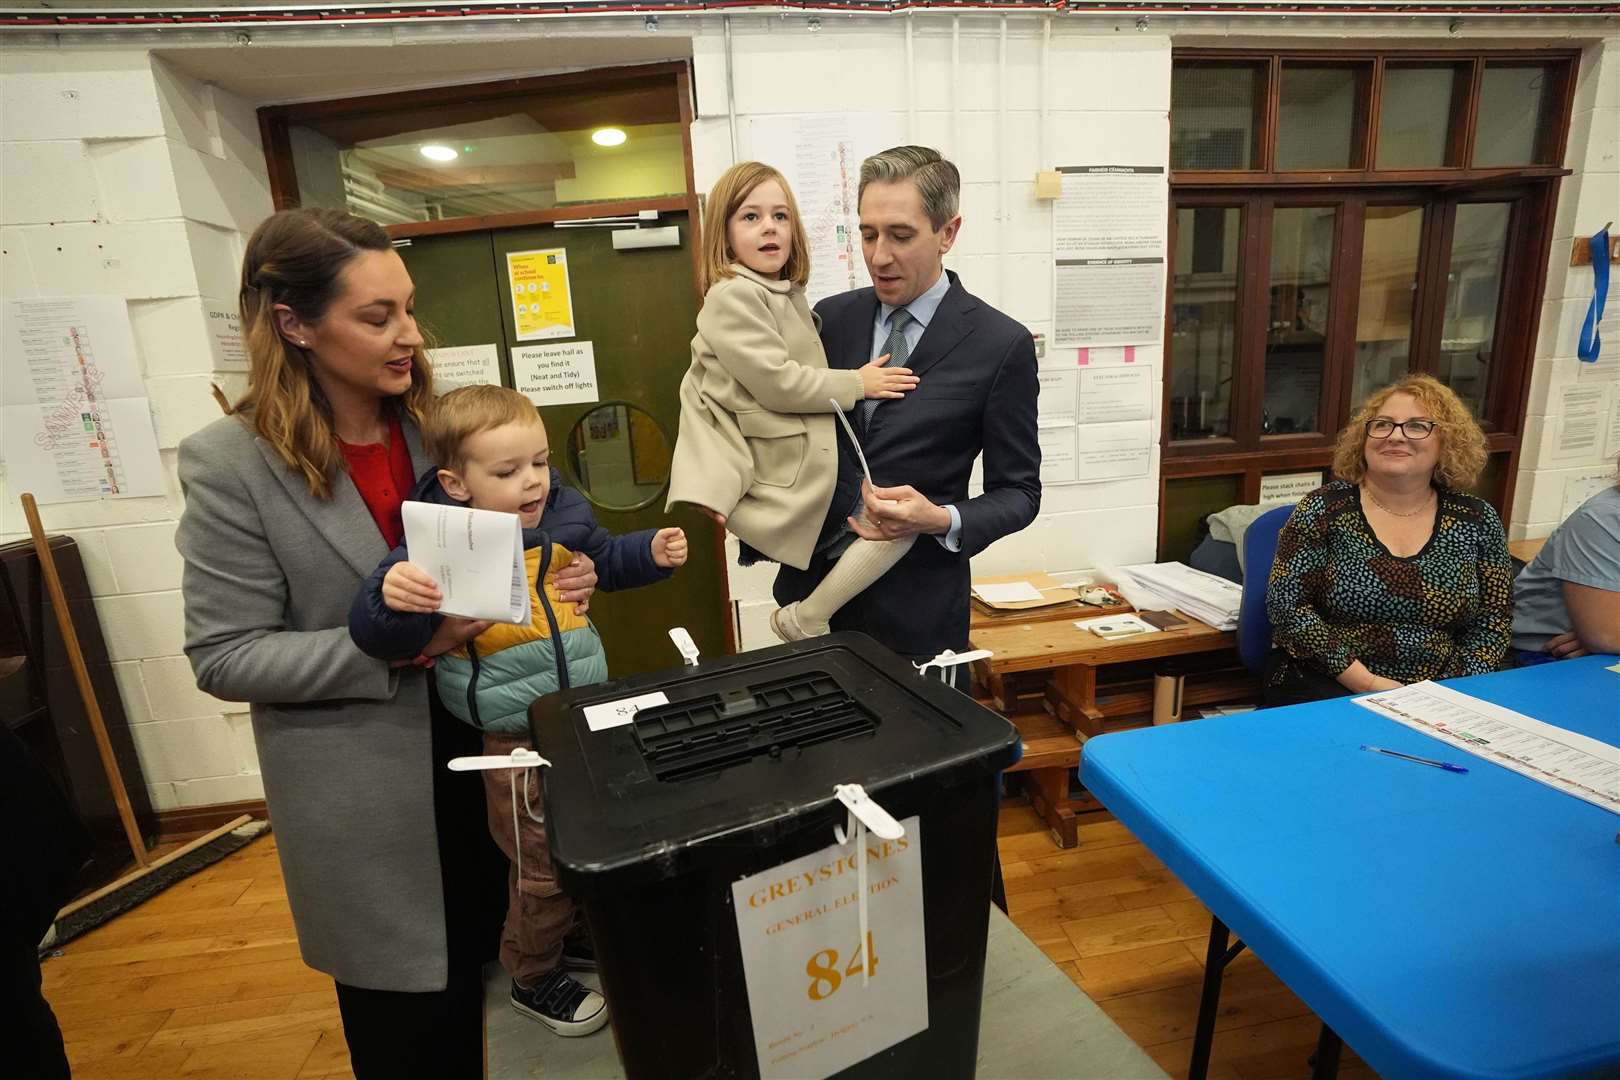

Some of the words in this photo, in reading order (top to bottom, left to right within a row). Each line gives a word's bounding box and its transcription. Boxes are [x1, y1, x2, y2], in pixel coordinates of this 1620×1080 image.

[530, 373, 548, 382] (Neat
[564, 371, 580, 380] Tidy)
[575, 382, 593, 390] lights
[748, 837, 909, 908] GREYSTONES
[766, 904, 831, 936] GENERAL
[834, 876, 898, 909] ELETION
[806, 929, 879, 1001] 84
